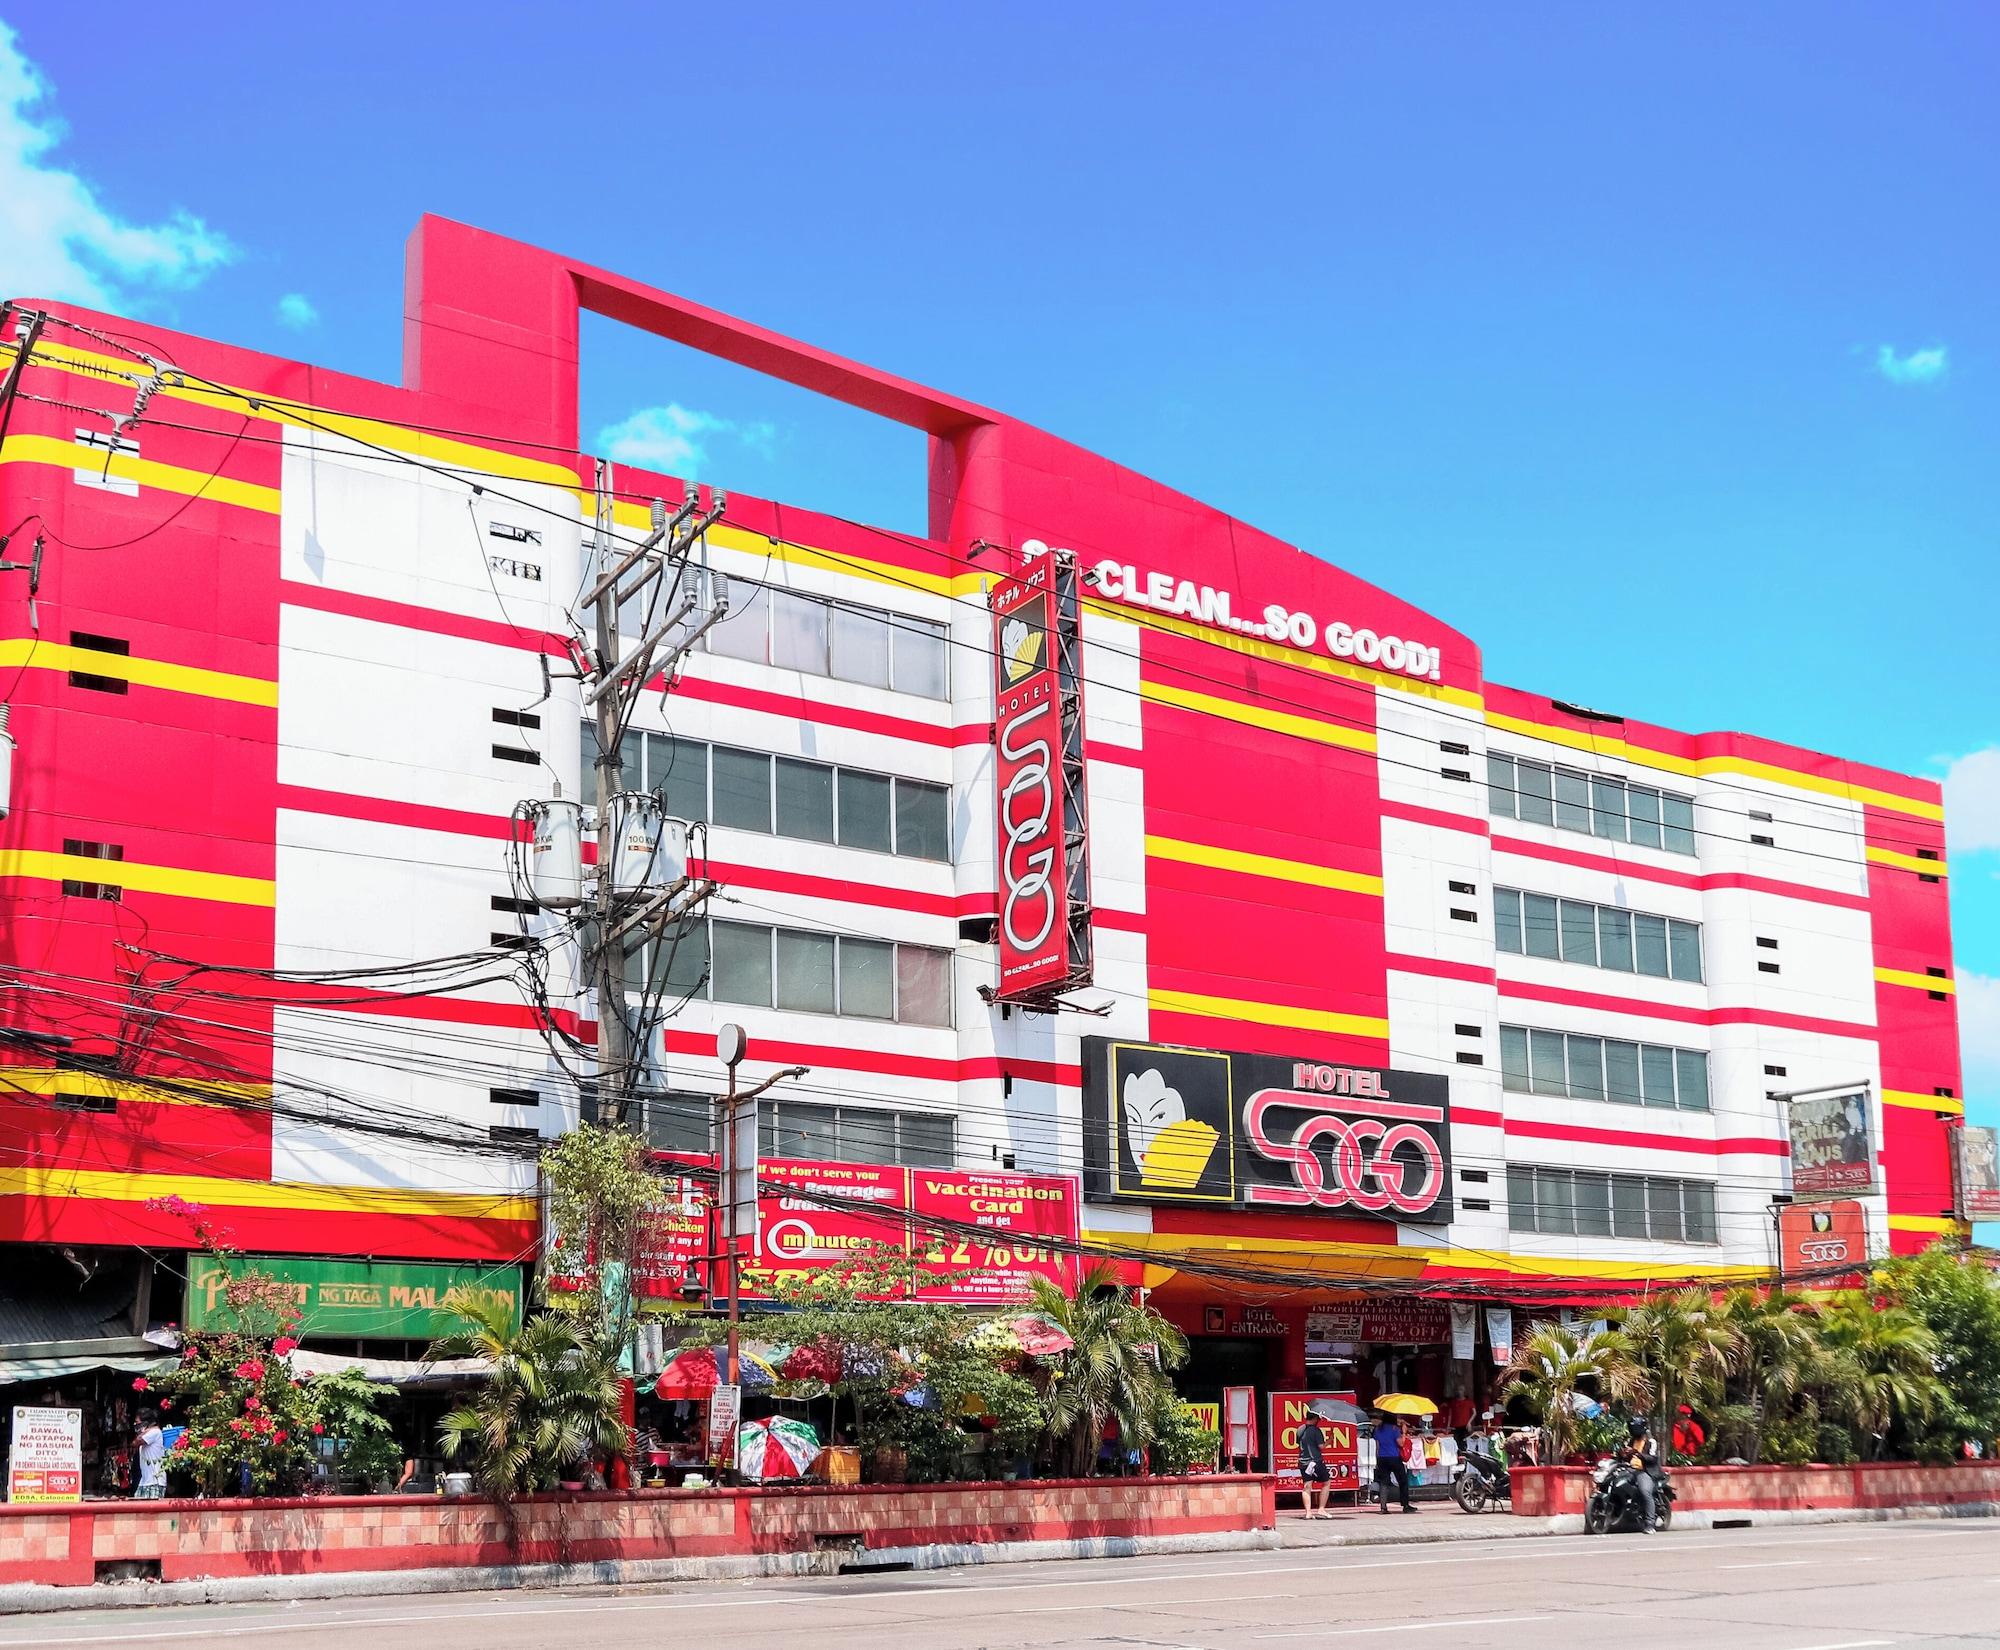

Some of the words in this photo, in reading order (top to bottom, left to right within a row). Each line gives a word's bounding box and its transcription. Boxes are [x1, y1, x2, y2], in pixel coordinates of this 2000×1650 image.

[997, 584, 1020, 608] ホテル
[1324, 621, 1442, 682] GOOD!
[998, 681, 1050, 716] HOTEL
[628, 835, 645, 844] 100
[1293, 1063, 1390, 1099] HOTEL
[1791, 1124, 1843, 1142] GRILL
[1242, 1088, 1445, 1214] SOGO
[770, 1167, 787, 1175] we
[790, 1167, 820, 1177] don't
[823, 1169, 853, 1179] serve
[856, 1172, 880, 1181] your
[969, 1199, 1023, 1214] Card
[976, 1215, 994, 1224] and
[996, 1216, 1011, 1227] get
[677, 1237, 692, 1248] any
[693, 1237, 703, 1246] of
[1800, 1239, 1848, 1263] SOGO
[319, 1288, 339, 1301] NG
[342, 1289, 379, 1301] TAGA
[1243, 1309, 1276, 1321] HOTEL
[1312, 1305, 1369, 1313] IMPORTED
[1231, 1321, 1290, 1335] ENTRANCE
[1371, 1325, 1386, 1337] 90
[1391, 1326, 1404, 1337] %
[1409, 1326, 1439, 1337] OFF
[20, 1434, 74, 1442] MAGTAPON
[1281, 1426, 1351, 1450] OEN
